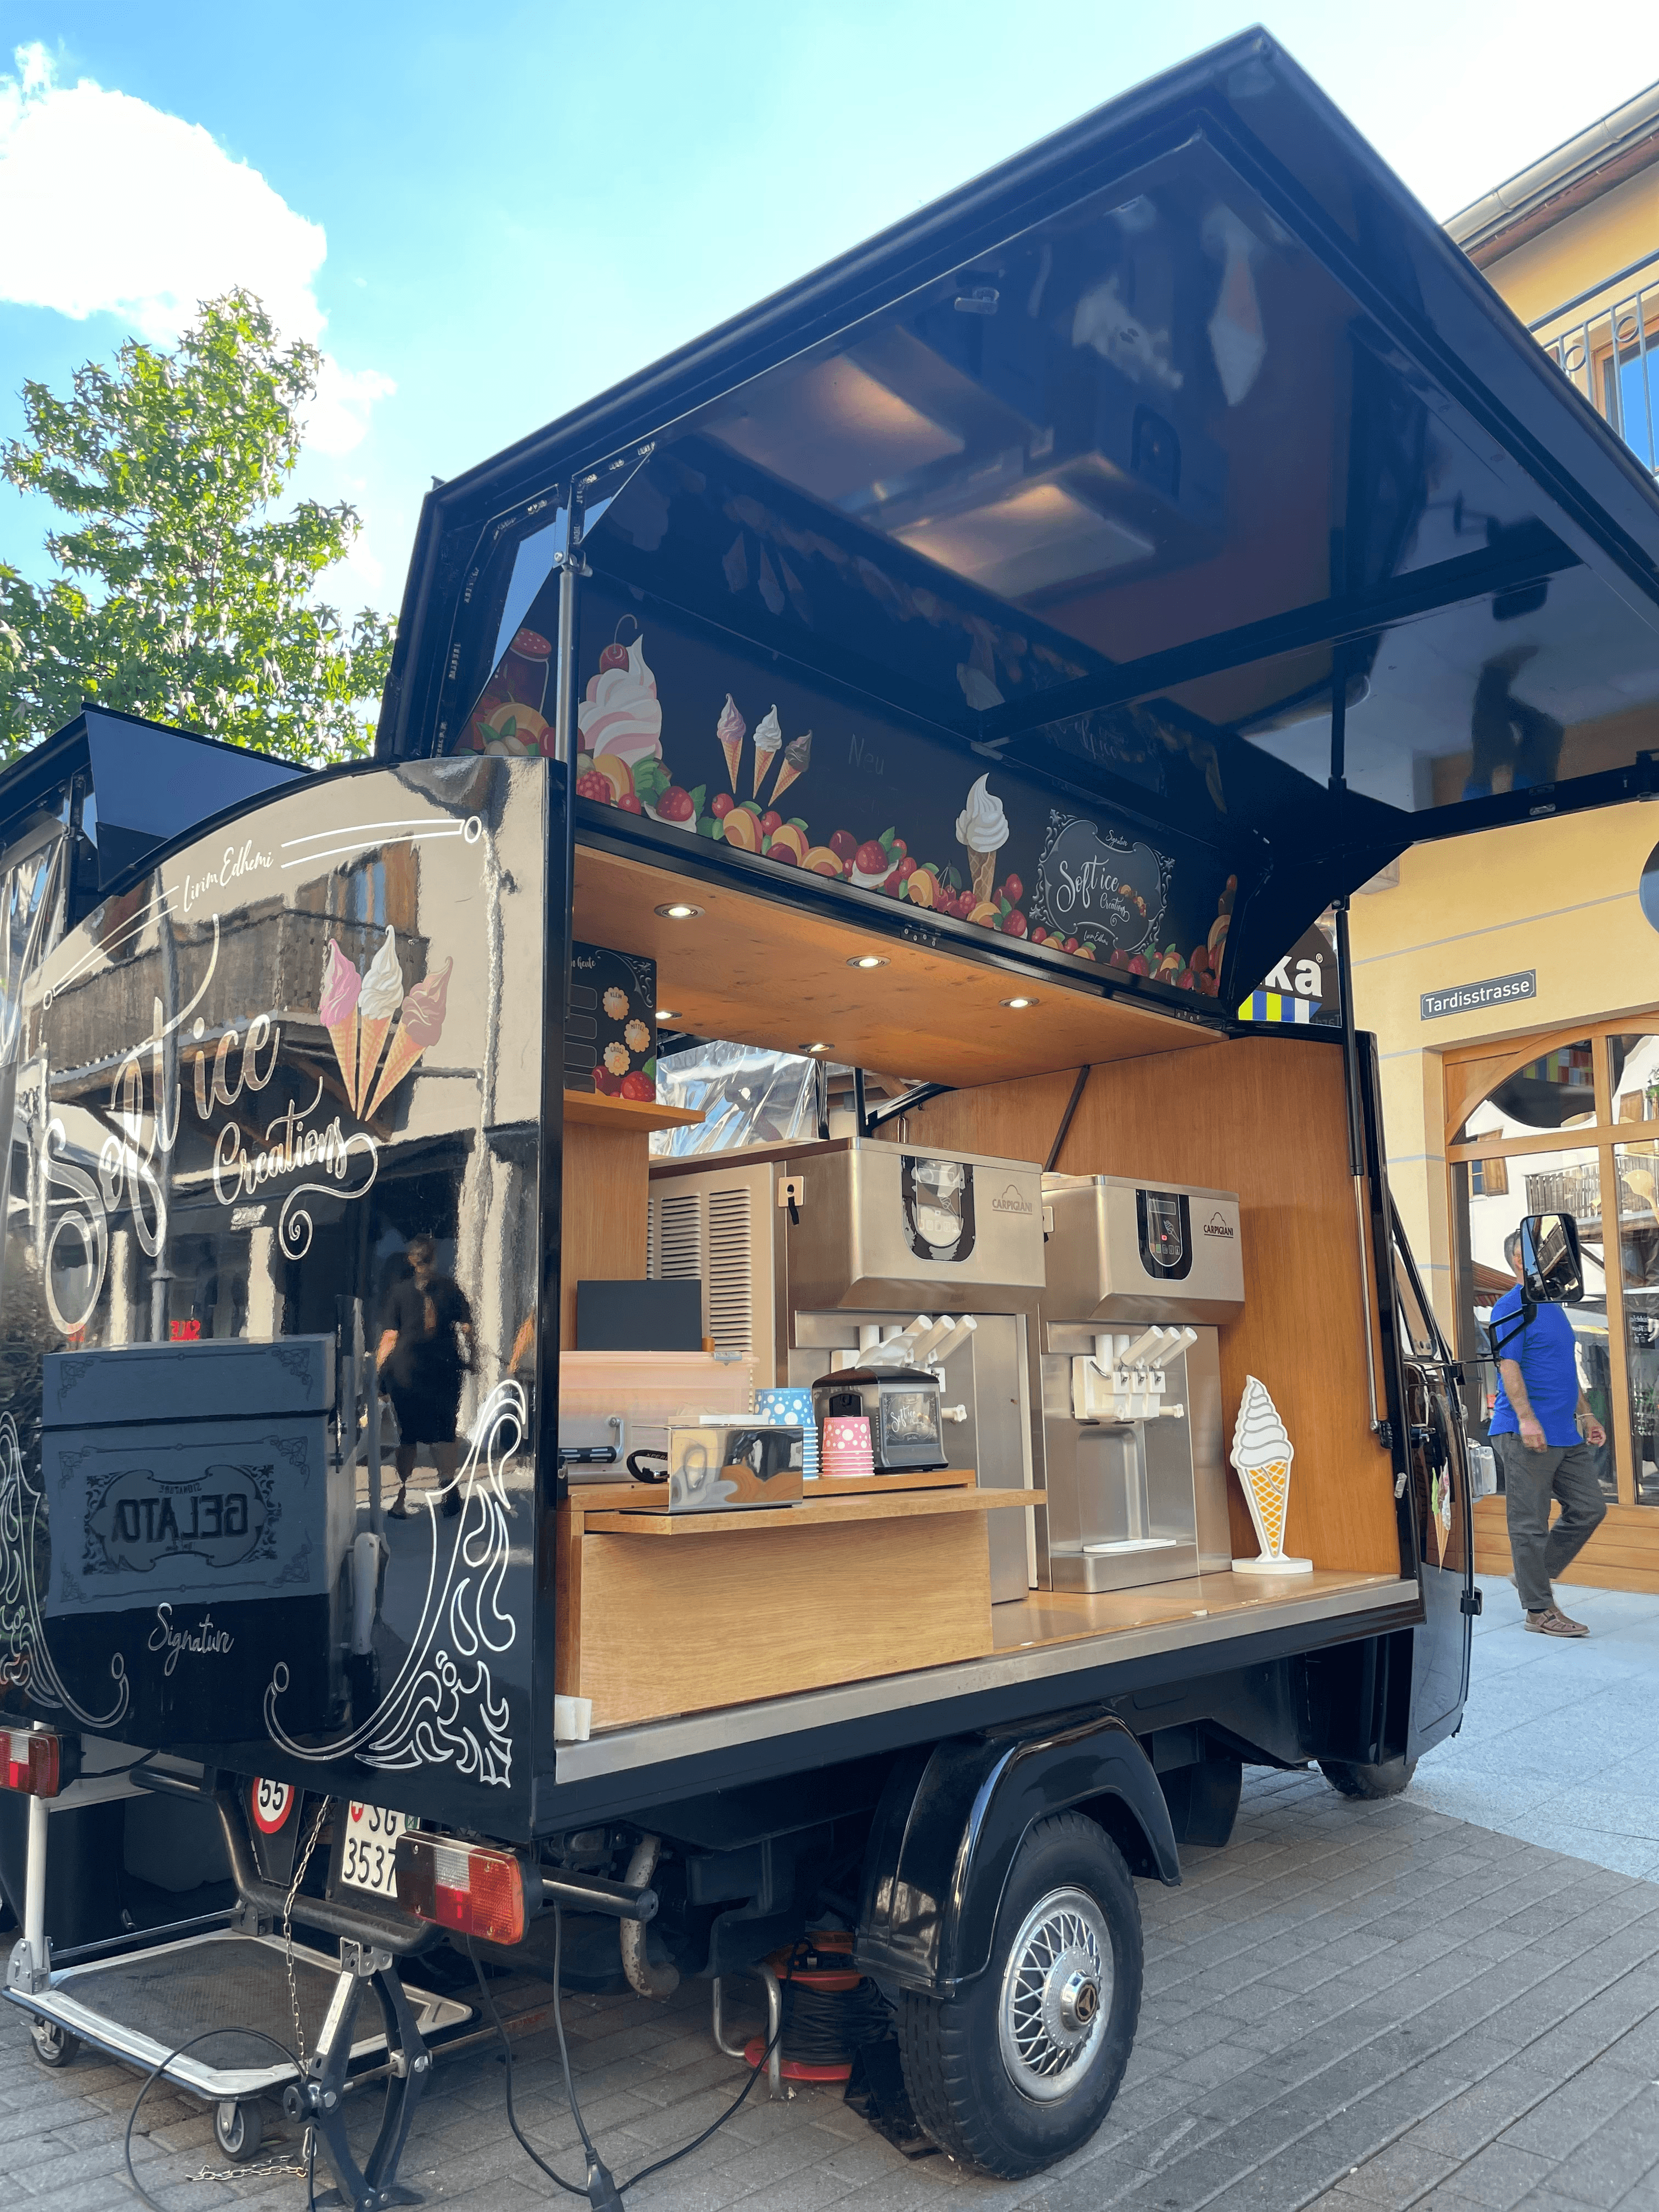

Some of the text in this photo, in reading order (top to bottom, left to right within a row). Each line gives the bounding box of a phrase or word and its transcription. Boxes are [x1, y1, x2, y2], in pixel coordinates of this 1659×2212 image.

[220, 839, 274, 887] Edhemi
[1057, 855, 1120, 912] Soft ice
[577, 956, 596, 969] heute
[1425, 980, 1530, 1013] Tardisstrasse
[42, 913, 280, 1335] Soft ice
[992, 1199, 1032, 1212] CARPIGIANI
[1203, 1224, 1234, 1236] CARPIGIANI
[148, 1602, 235, 1677] Signature
[259, 1779, 284, 1810] 55
